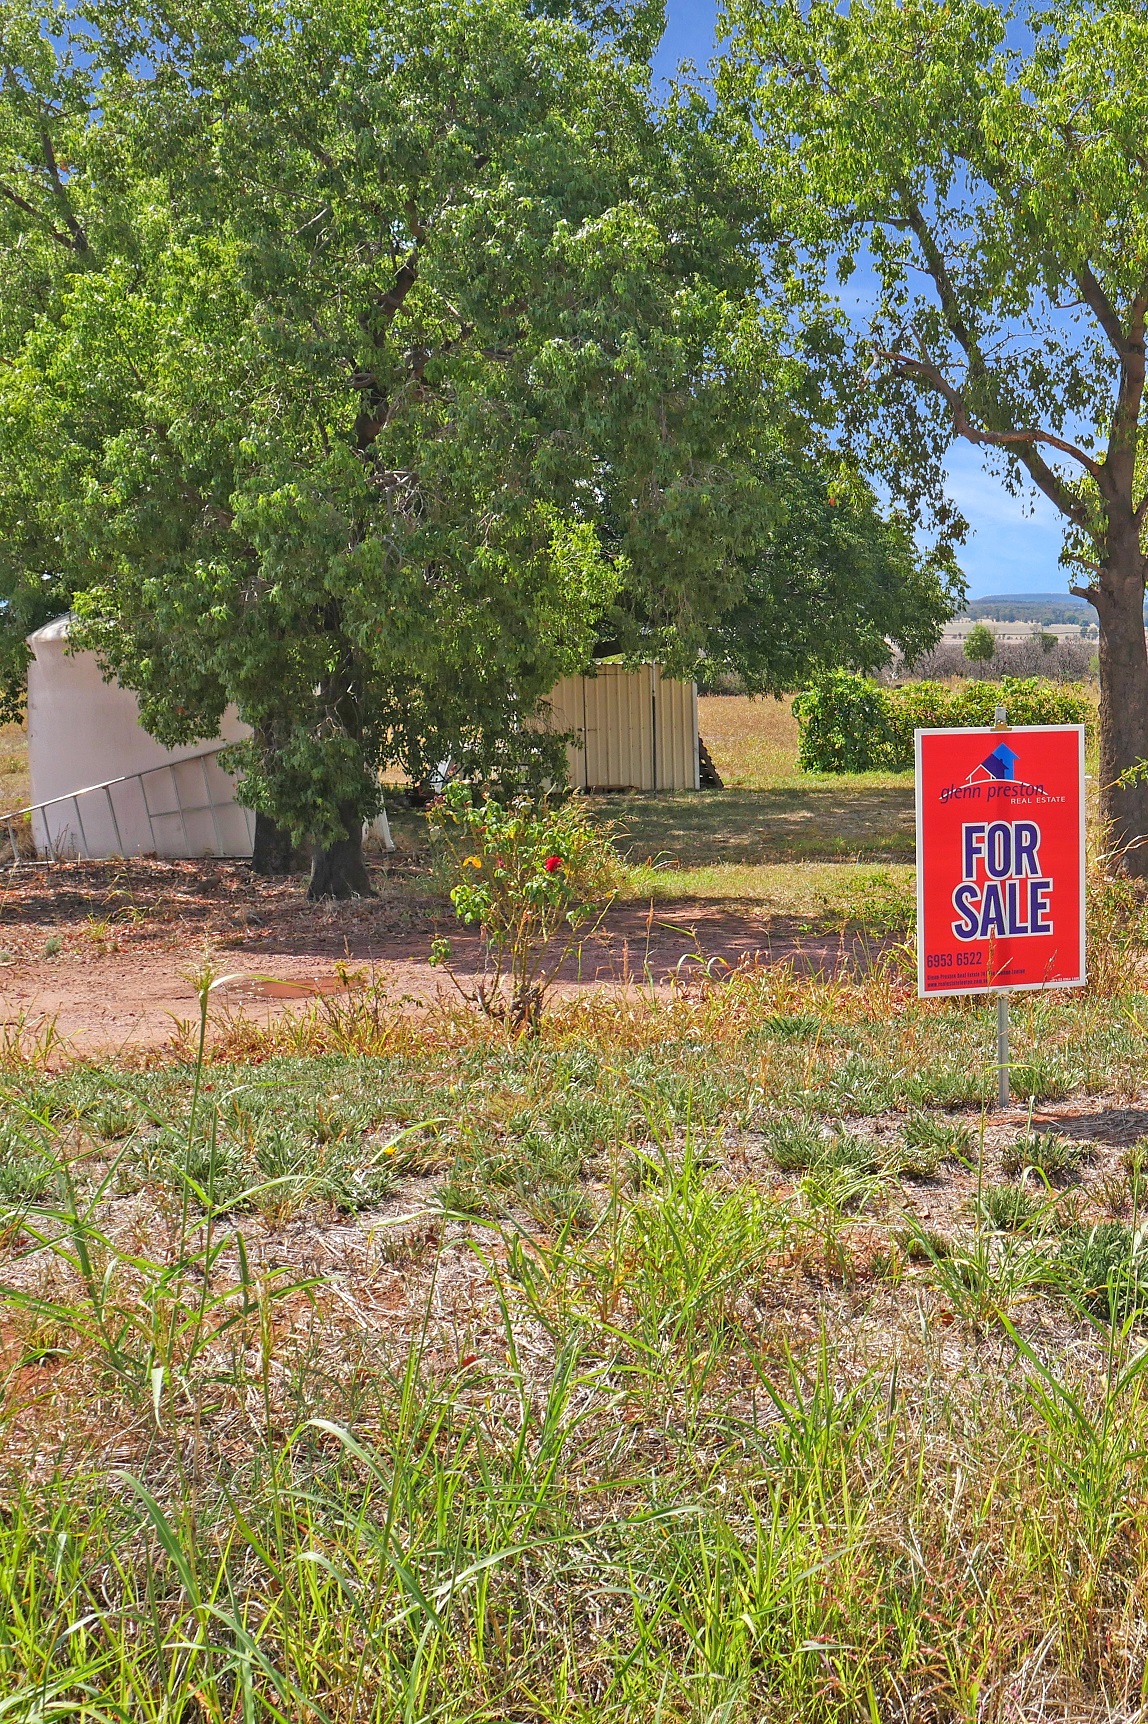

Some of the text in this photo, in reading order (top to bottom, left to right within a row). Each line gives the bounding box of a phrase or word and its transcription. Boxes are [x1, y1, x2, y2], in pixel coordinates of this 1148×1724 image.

[940, 783, 1044, 804] glenn preston
[1010, 796, 1066, 805] REAL ESTATE
[962, 820, 1042, 881] FOR
[951, 878, 1053, 942] SALE
[927, 951, 982, 968] 6953 6522
